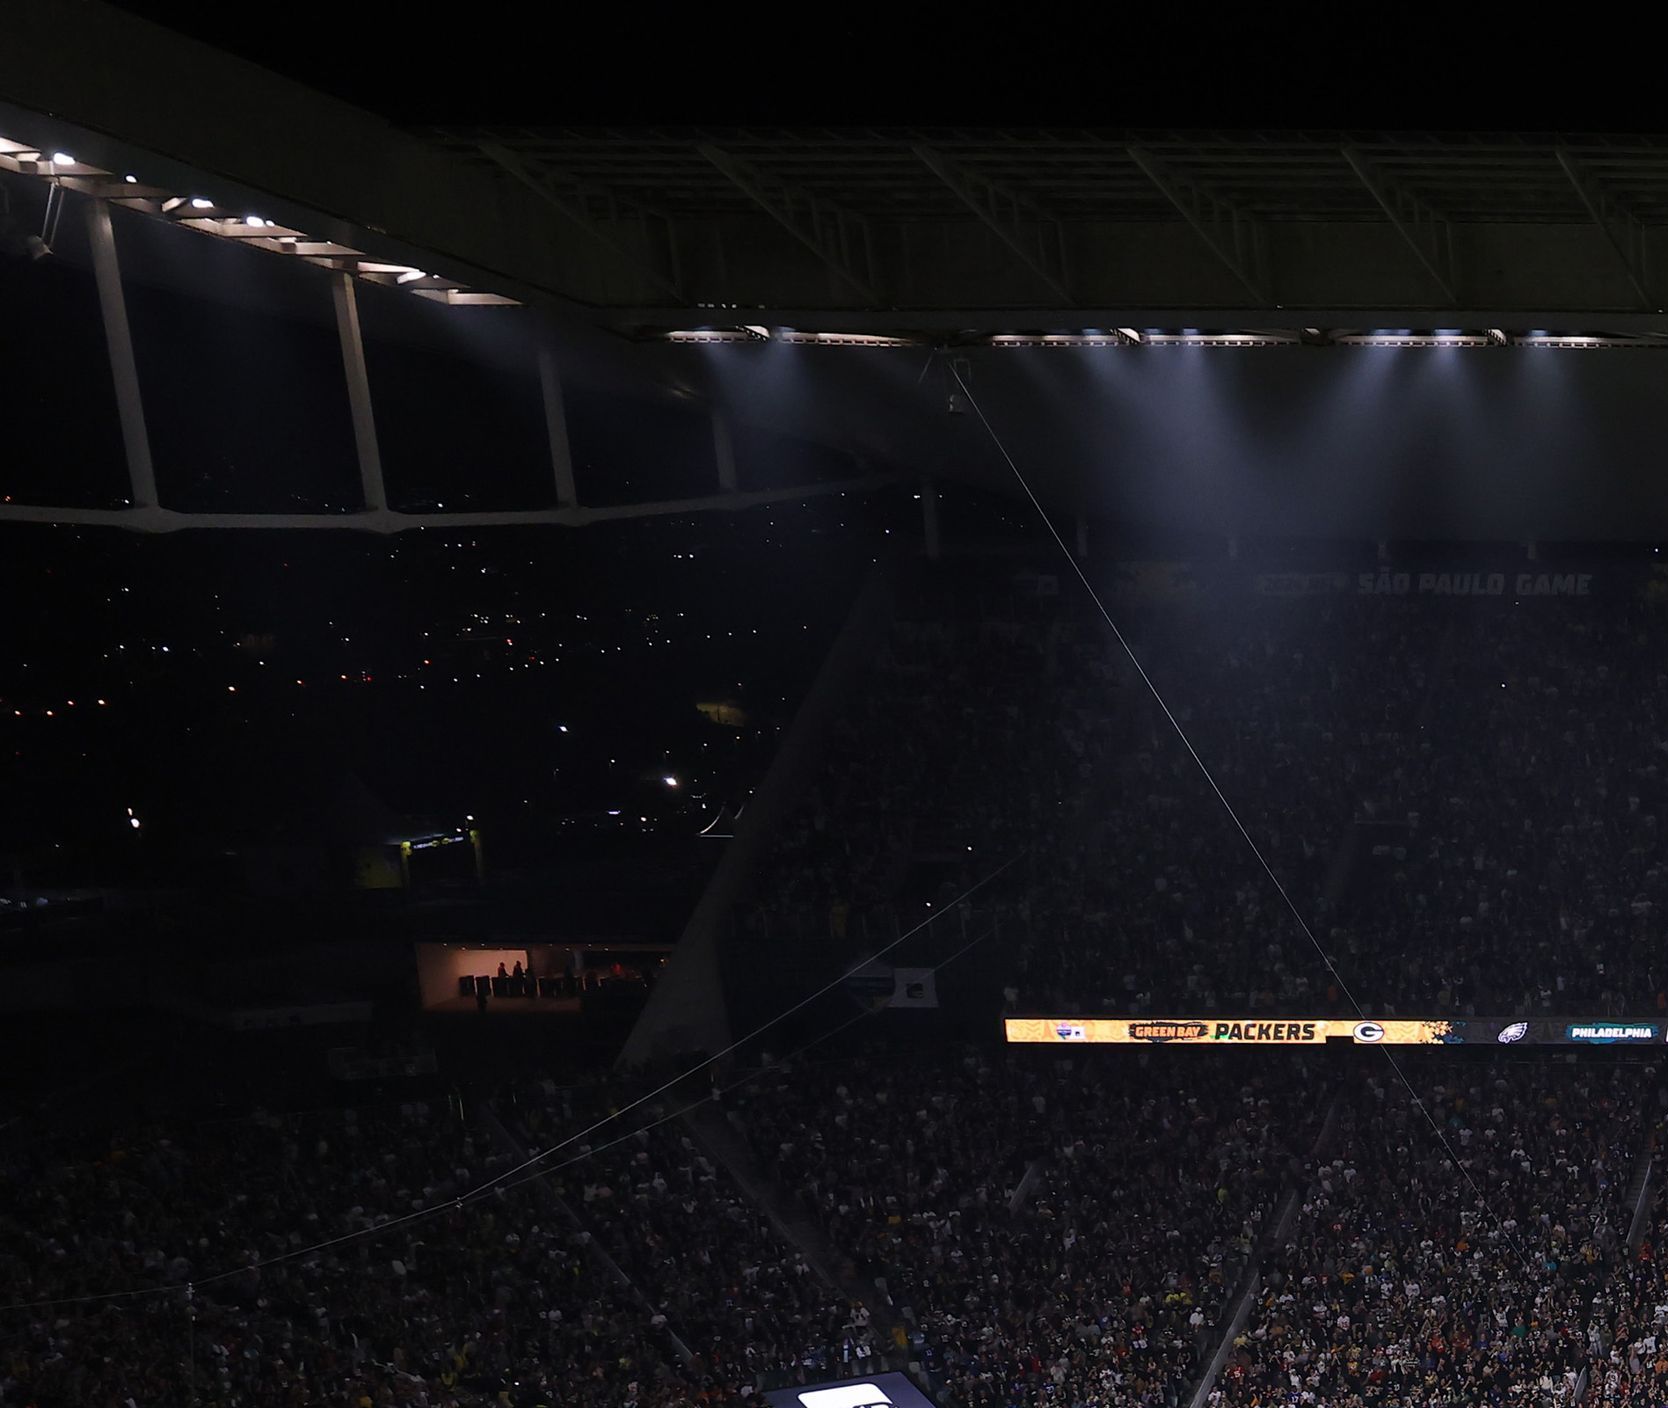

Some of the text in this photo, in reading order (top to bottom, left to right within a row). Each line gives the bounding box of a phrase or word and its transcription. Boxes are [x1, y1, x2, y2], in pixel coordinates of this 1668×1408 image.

[1358, 571, 1409, 595] SÃO
[1418, 573, 1504, 596] PAULO
[1515, 573, 1592, 596] GAME
[1134, 1023, 1315, 1041] GREEN BAY PACKERS
[1571, 1026, 1653, 1039] PHILADELPHIA
